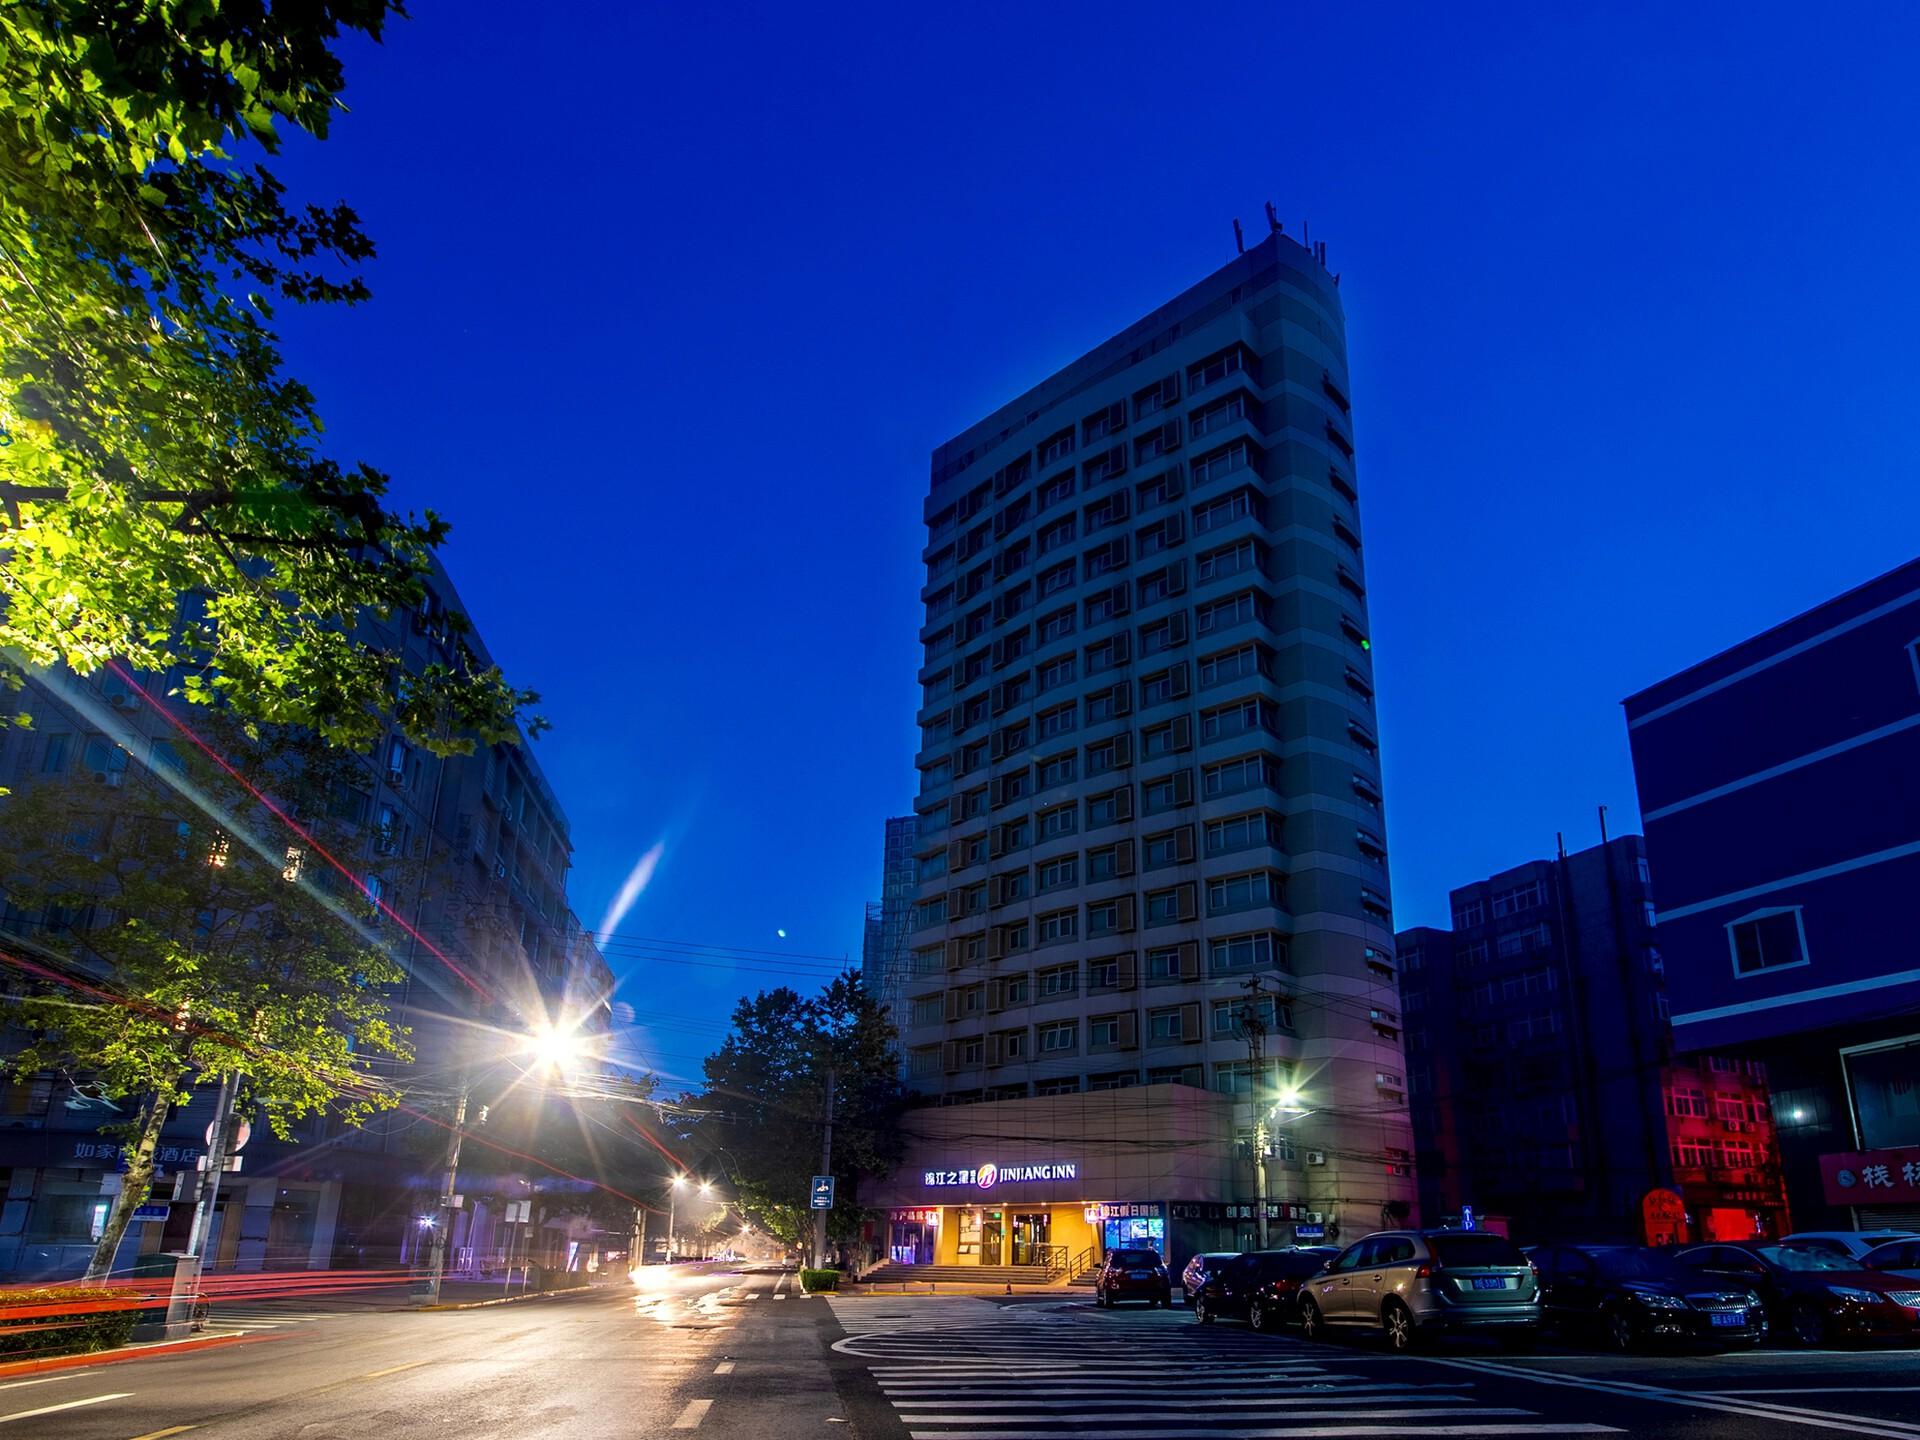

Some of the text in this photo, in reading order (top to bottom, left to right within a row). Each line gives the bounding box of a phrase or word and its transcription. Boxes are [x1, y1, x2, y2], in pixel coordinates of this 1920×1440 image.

[74, 1142, 199, 1162] 如家酒店
[1000, 1165, 1075, 1182] JINJIANG INN
